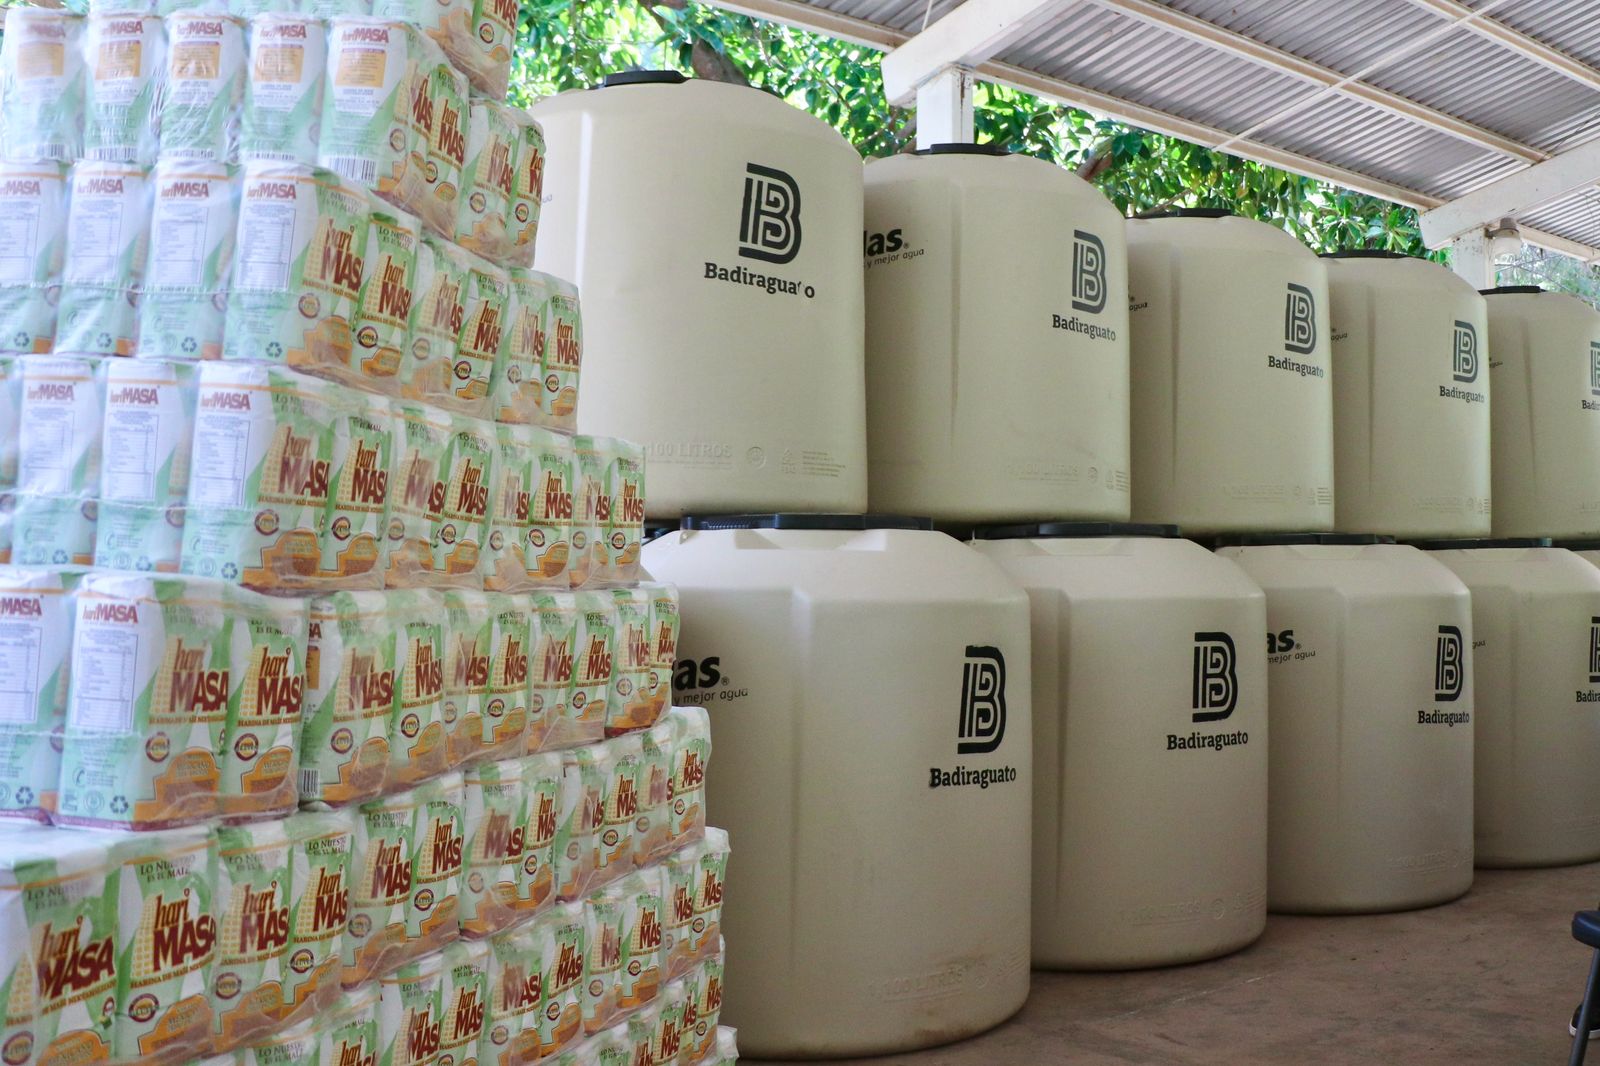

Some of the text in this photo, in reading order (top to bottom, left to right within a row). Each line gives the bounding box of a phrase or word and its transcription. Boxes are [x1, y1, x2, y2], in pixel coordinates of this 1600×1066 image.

[902, 248, 925, 260] agua
[704, 262, 815, 298] Badiraguao
[1052, 313, 1117, 341] Badiraguato
[1268, 355, 1324, 378] Badiraguato
[351, 467, 388, 505] MAS
[259, 645, 292, 678] hari
[683, 690, 717, 704] mejor
[1417, 710, 1470, 727] Badiraguato
[1166, 730, 1249, 750] Badiraguato
[929, 765, 1017, 789] Badiraguato
[309, 840, 319, 851] LO
[140, 864, 154, 876] LO
[317, 863, 344, 897] hari
[154, 888, 191, 930] hari
